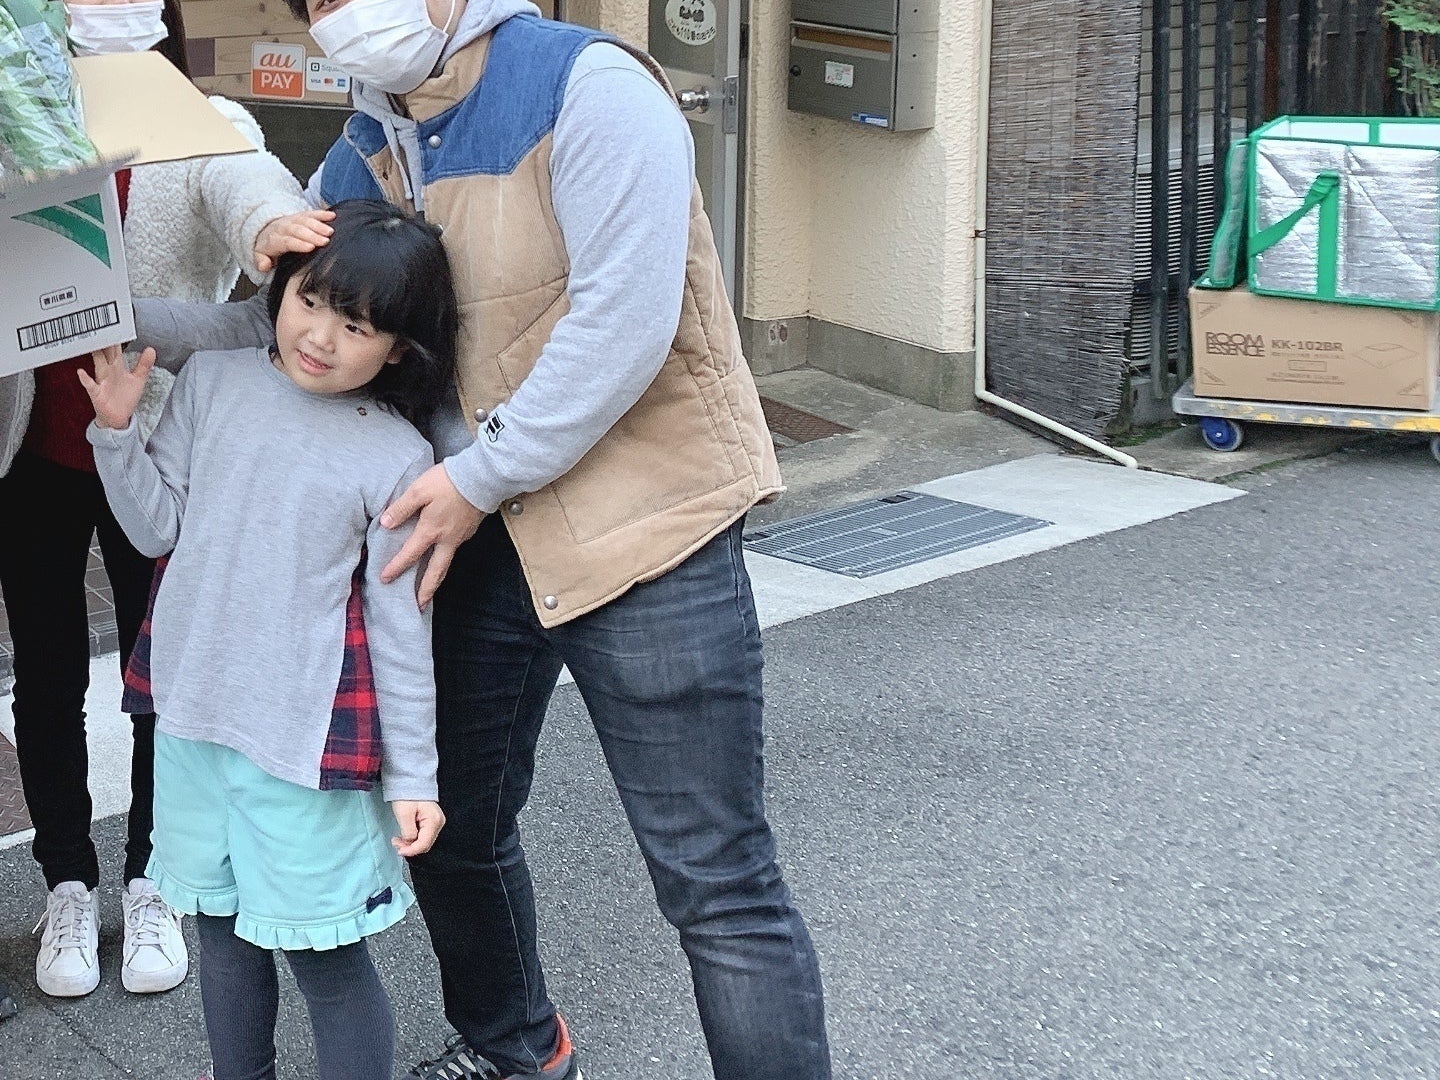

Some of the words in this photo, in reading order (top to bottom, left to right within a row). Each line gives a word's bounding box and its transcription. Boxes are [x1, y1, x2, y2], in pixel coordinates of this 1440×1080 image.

[260, 52, 297, 69] au
[260, 72, 295, 89] PAY
[1205, 331, 1264, 347] ROOM
[1271, 339, 1345, 352] KK-102BR
[1206, 344, 1266, 357] ESSENCE
